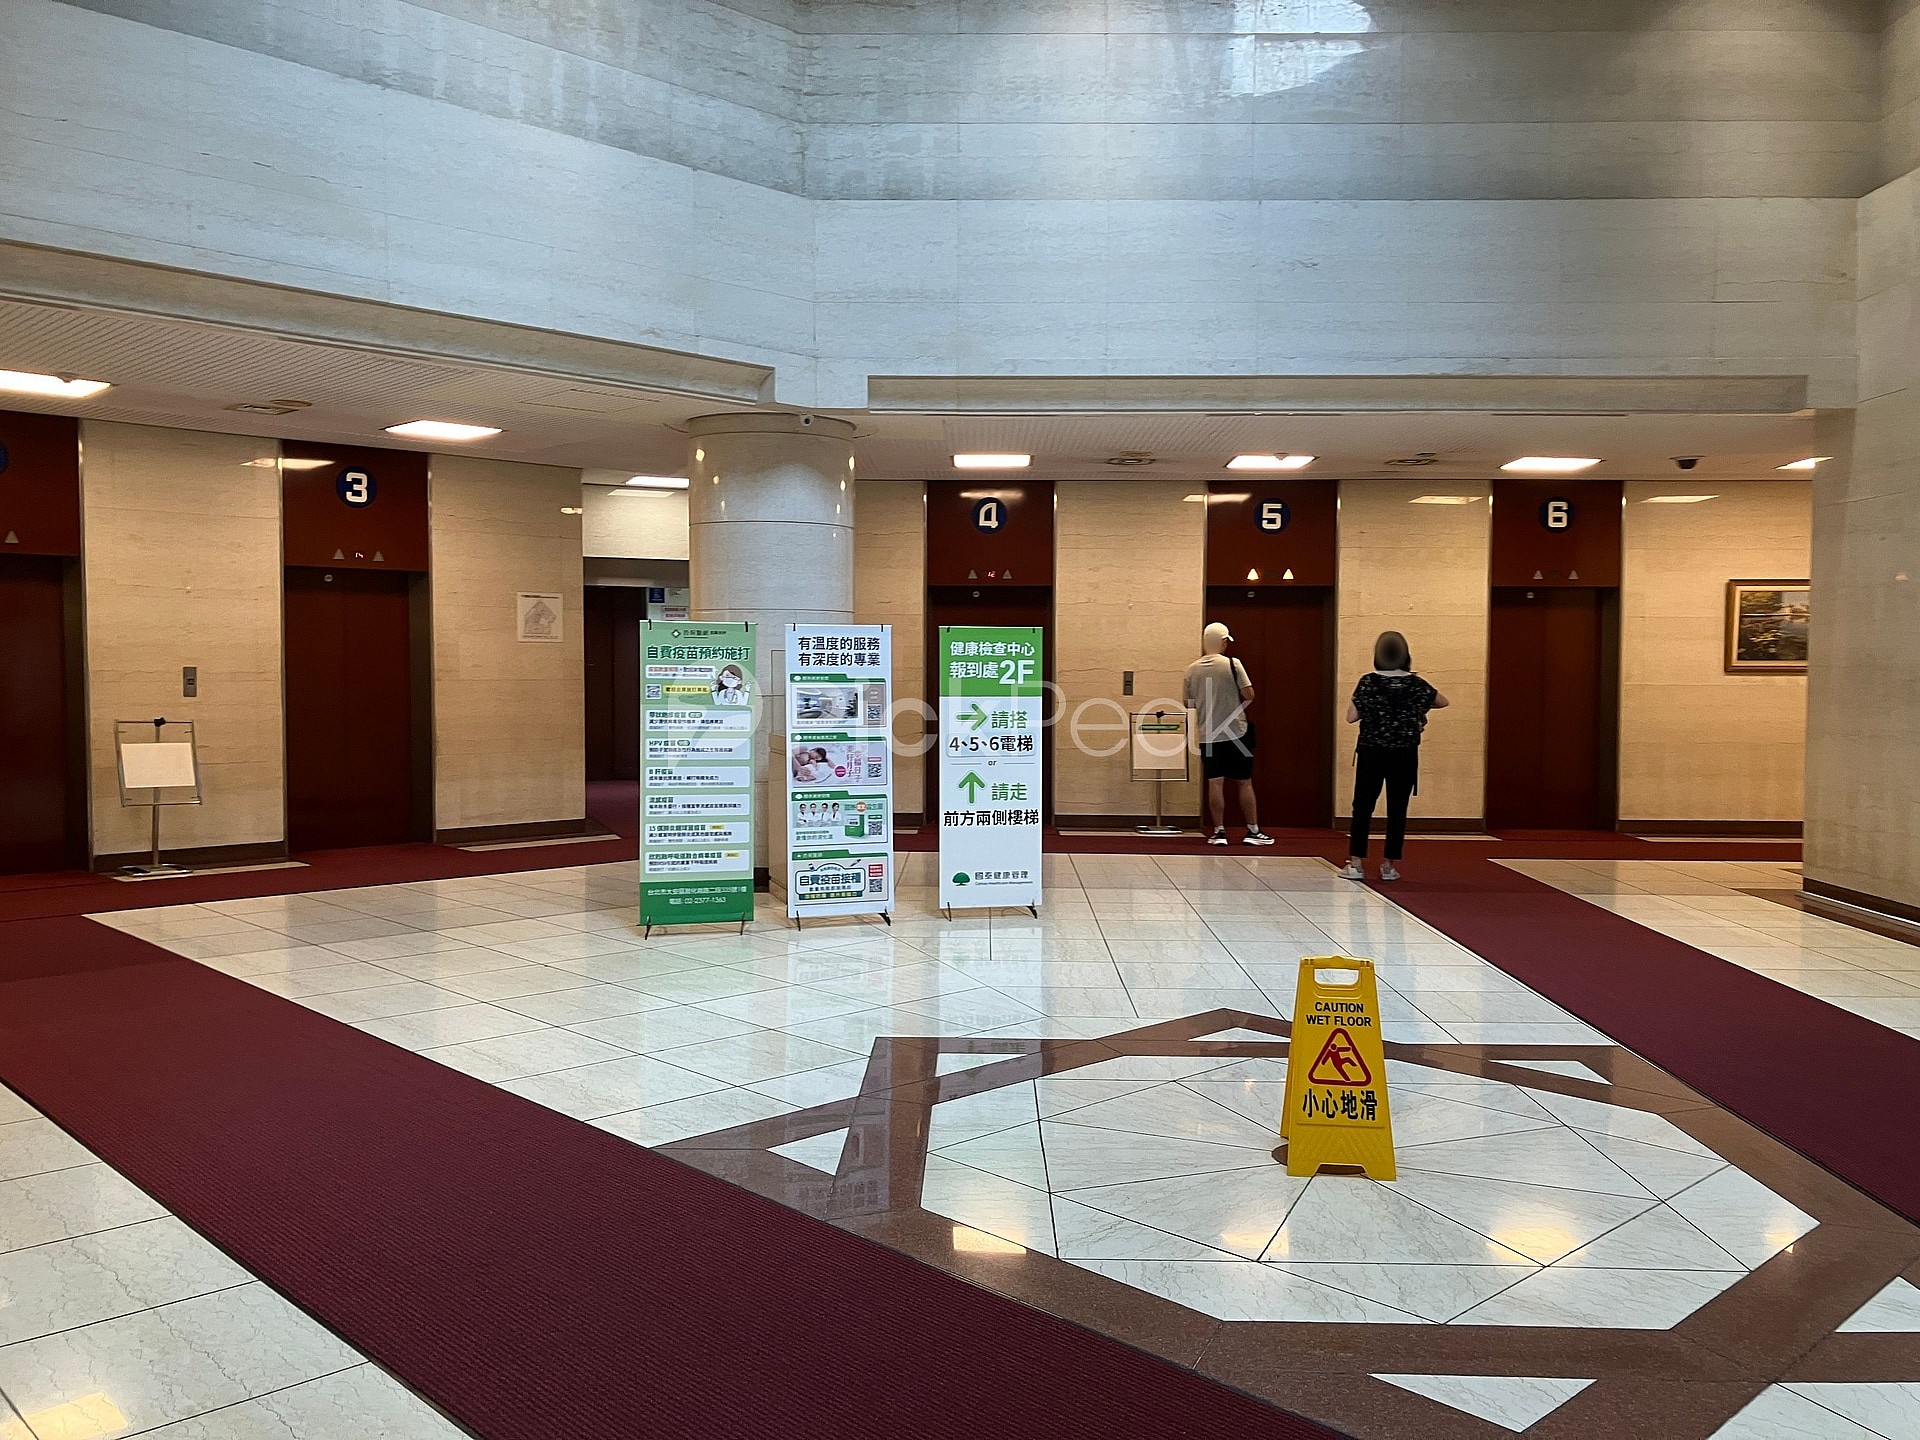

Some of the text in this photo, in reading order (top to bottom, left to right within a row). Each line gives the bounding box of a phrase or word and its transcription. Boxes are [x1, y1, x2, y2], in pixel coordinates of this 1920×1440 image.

[346, 472, 368, 503] 3
[979, 502, 999, 529] 4
[1262, 503, 1283, 530] 5
[1547, 501, 1569, 528] 6
[798, 636, 880, 651] 有溫度的服務
[950, 641, 1035, 656] 健康檢查中心
[647, 646, 751, 660] 自費疫苗預約施打
[798, 652, 881, 667] 有深度的專業
[991, 710, 1028, 729] 請搭
[991, 782, 1028, 801] 請走
[943, 809, 1039, 827] 前方兩側樓梯
[1315, 1001, 1364, 1014] CAUTION
[1306, 1014, 1372, 1027] WET FLOOR
[1302, 1088, 1378, 1121] 小心地滑
